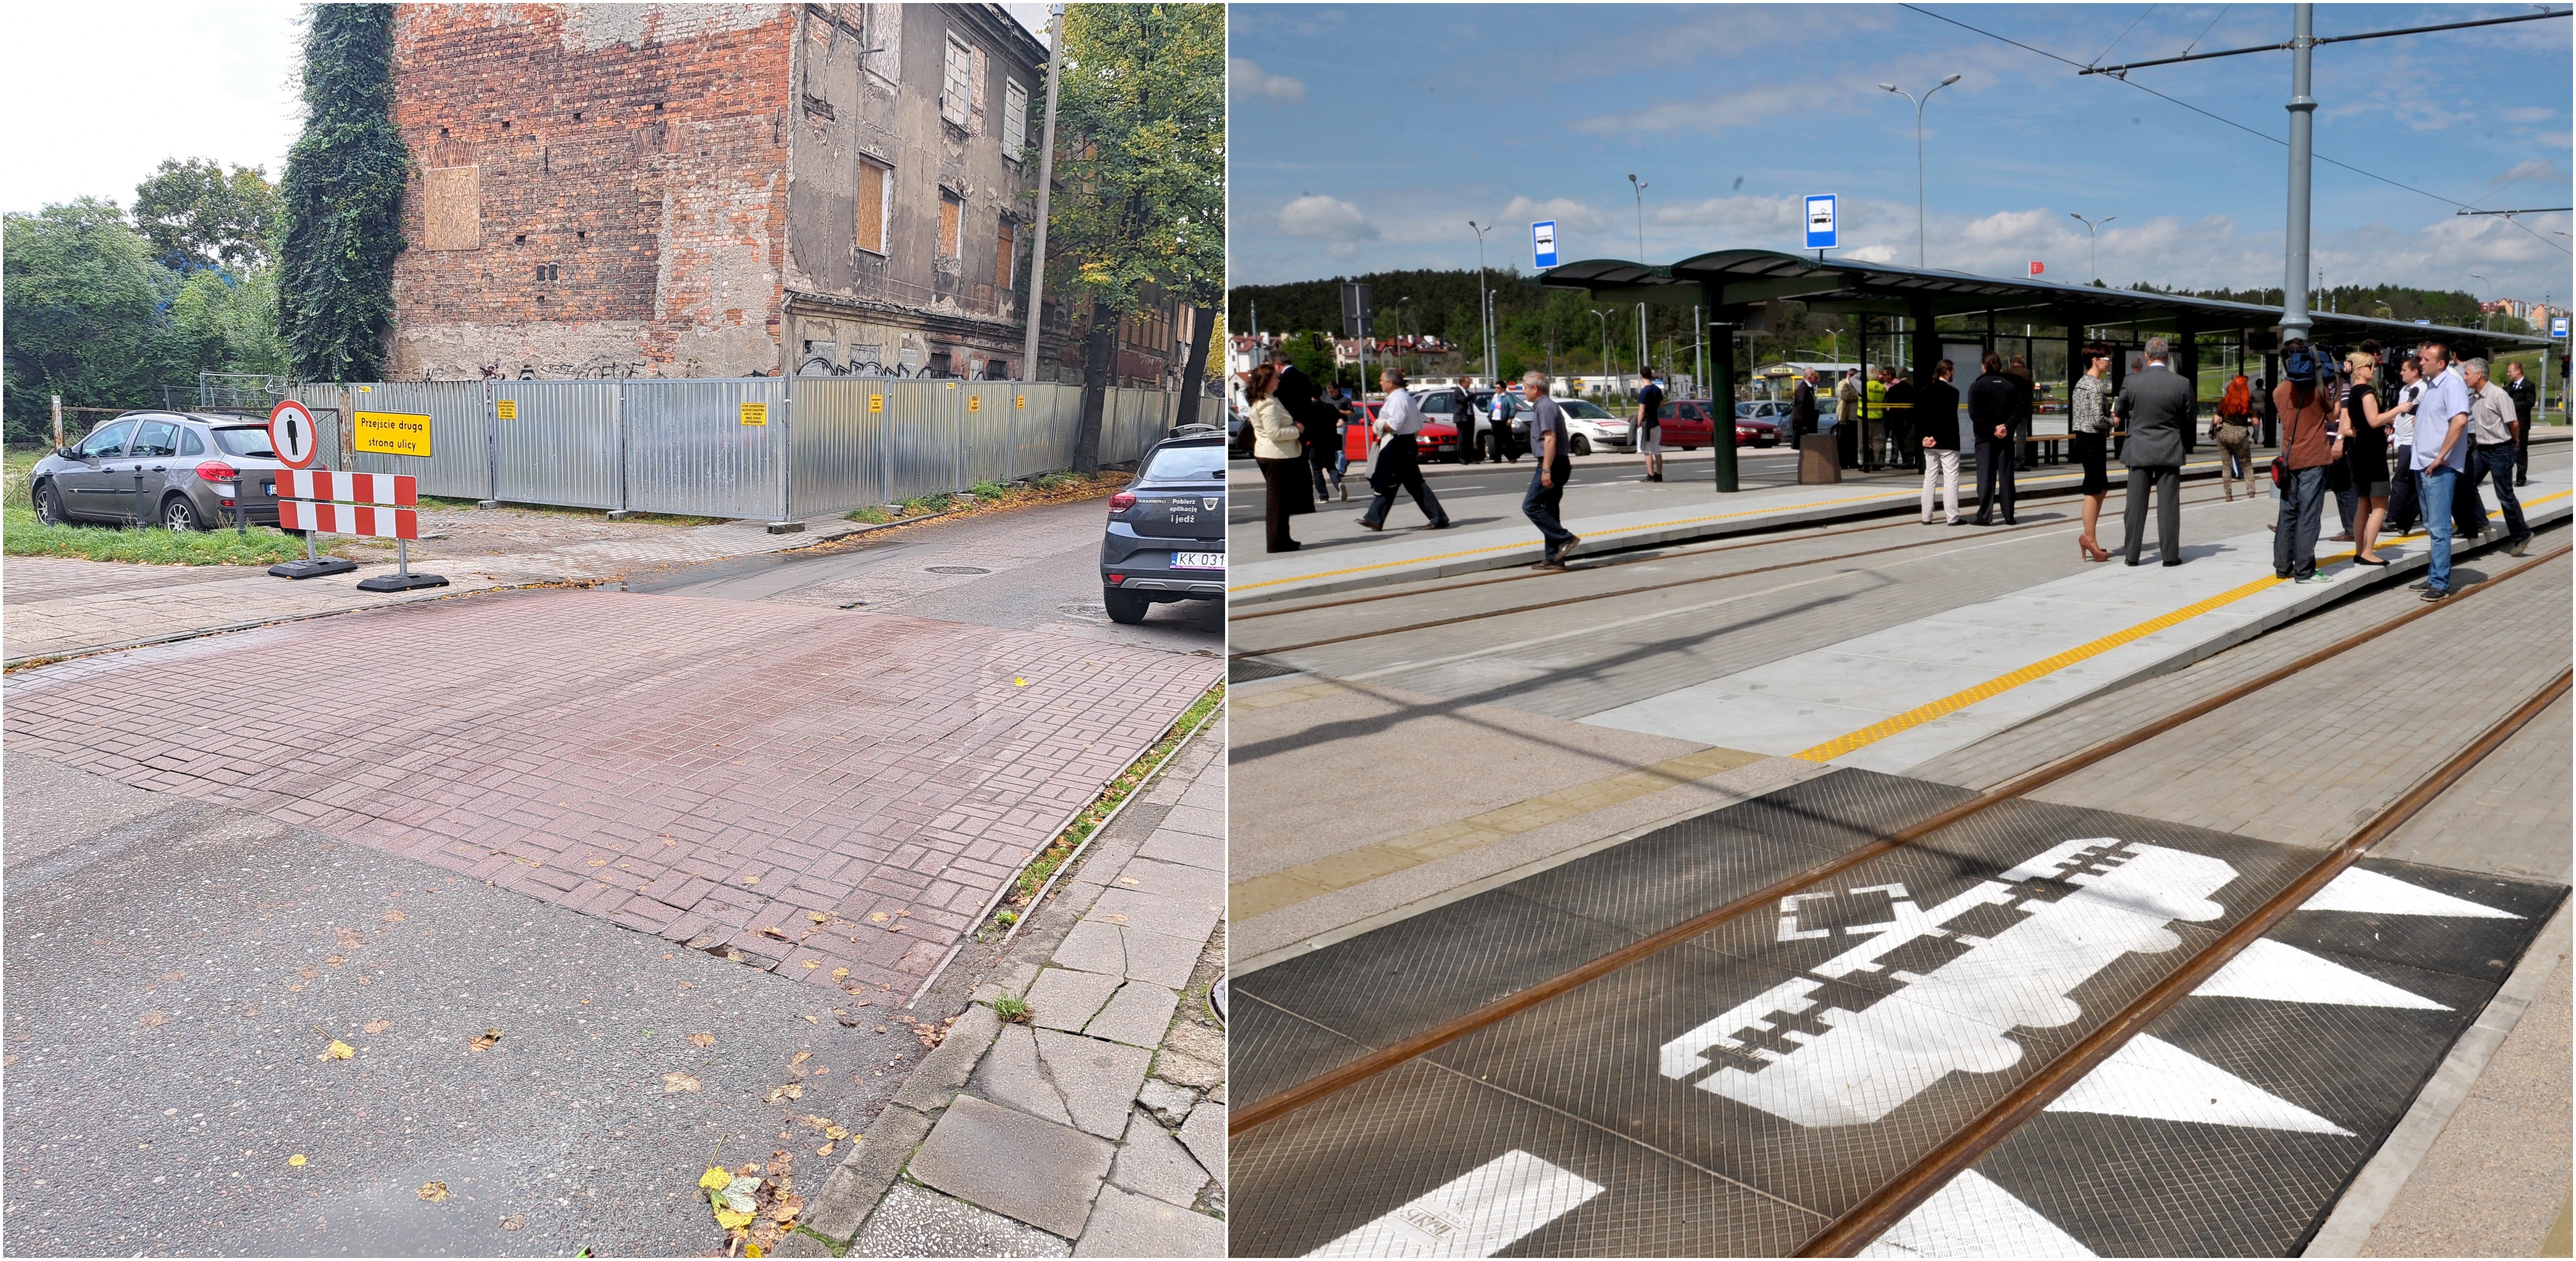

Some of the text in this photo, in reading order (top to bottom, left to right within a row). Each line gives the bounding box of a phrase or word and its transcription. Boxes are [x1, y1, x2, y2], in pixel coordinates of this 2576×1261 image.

[361, 418, 423, 433] Przejście drugą
[368, 437, 416, 452] stroną ulicy
[1171, 514, 1195, 524] i jedź
[1179, 553, 1196, 565] KK
